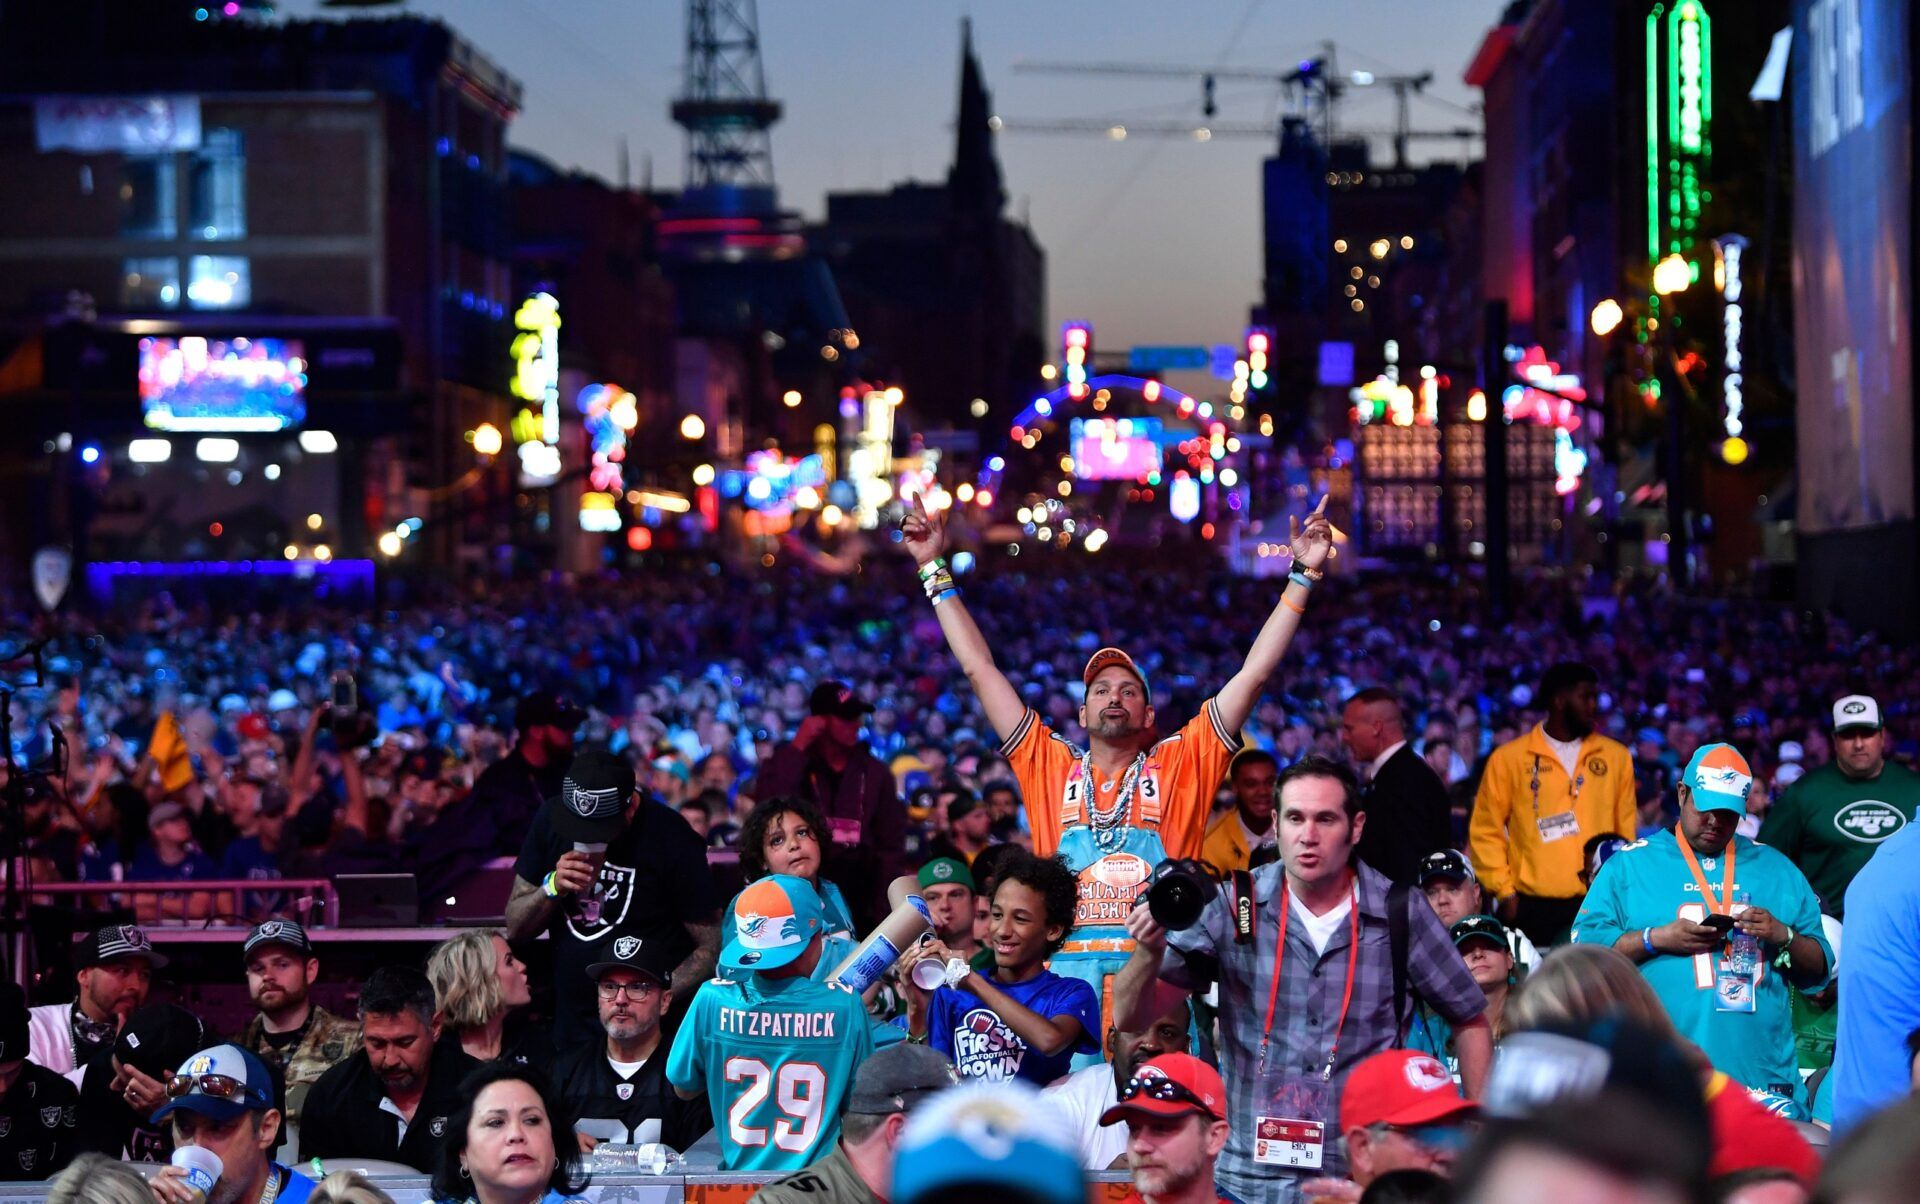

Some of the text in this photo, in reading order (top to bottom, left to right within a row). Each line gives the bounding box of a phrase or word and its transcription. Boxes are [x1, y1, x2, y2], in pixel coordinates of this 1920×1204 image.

[1069, 779, 1156, 801] 1 3
[1844, 815, 1897, 828] JETS
[1079, 881, 1138, 901] MIAMI
[1240, 896, 1252, 934] Canon
[720, 1007, 835, 1038] FITZPATRICK
[724, 1056, 827, 1154] 29
[195, 1170, 212, 1187] BUD
